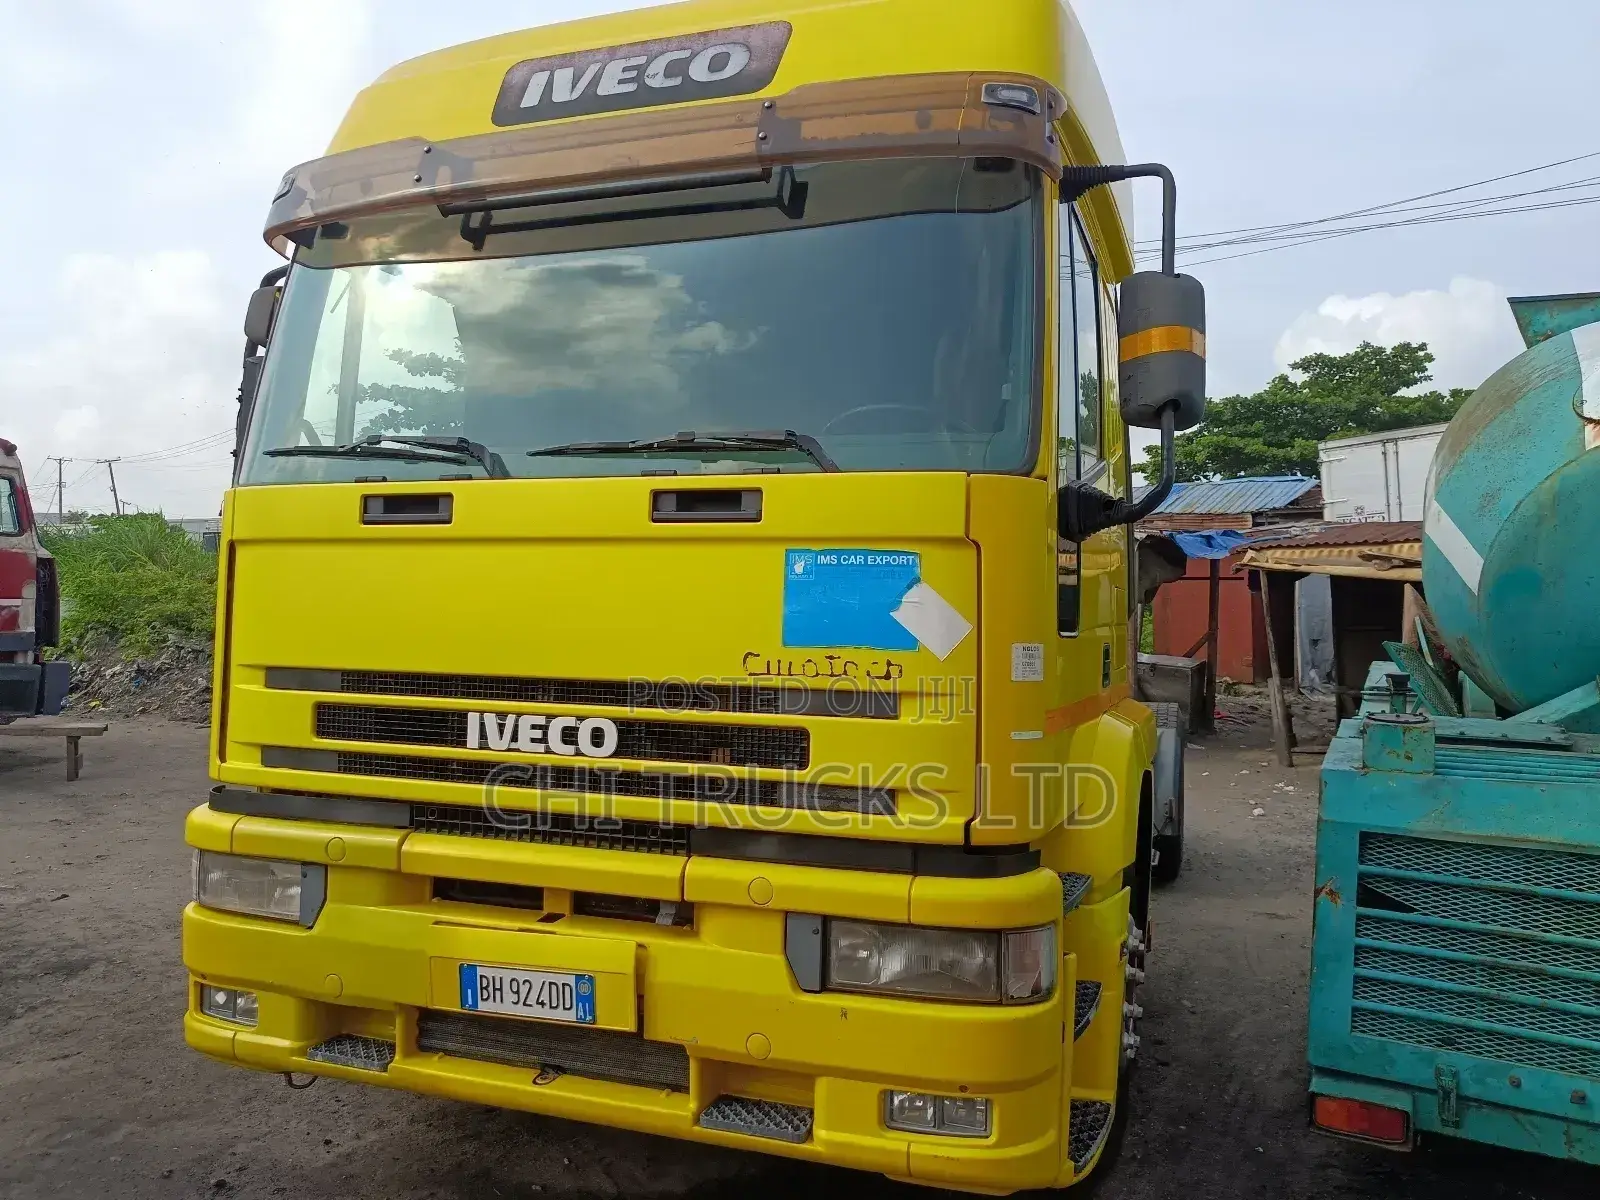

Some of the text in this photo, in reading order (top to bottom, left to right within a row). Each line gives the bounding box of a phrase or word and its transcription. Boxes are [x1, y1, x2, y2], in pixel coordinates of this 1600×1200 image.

[520, 41, 751, 109] IVECO
[817, 554, 915, 566] IMS CAR EXPORT
[466, 711, 619, 758] IVECO
[478, 973, 504, 1004] BH
[509, 976, 574, 1011] 924DD
